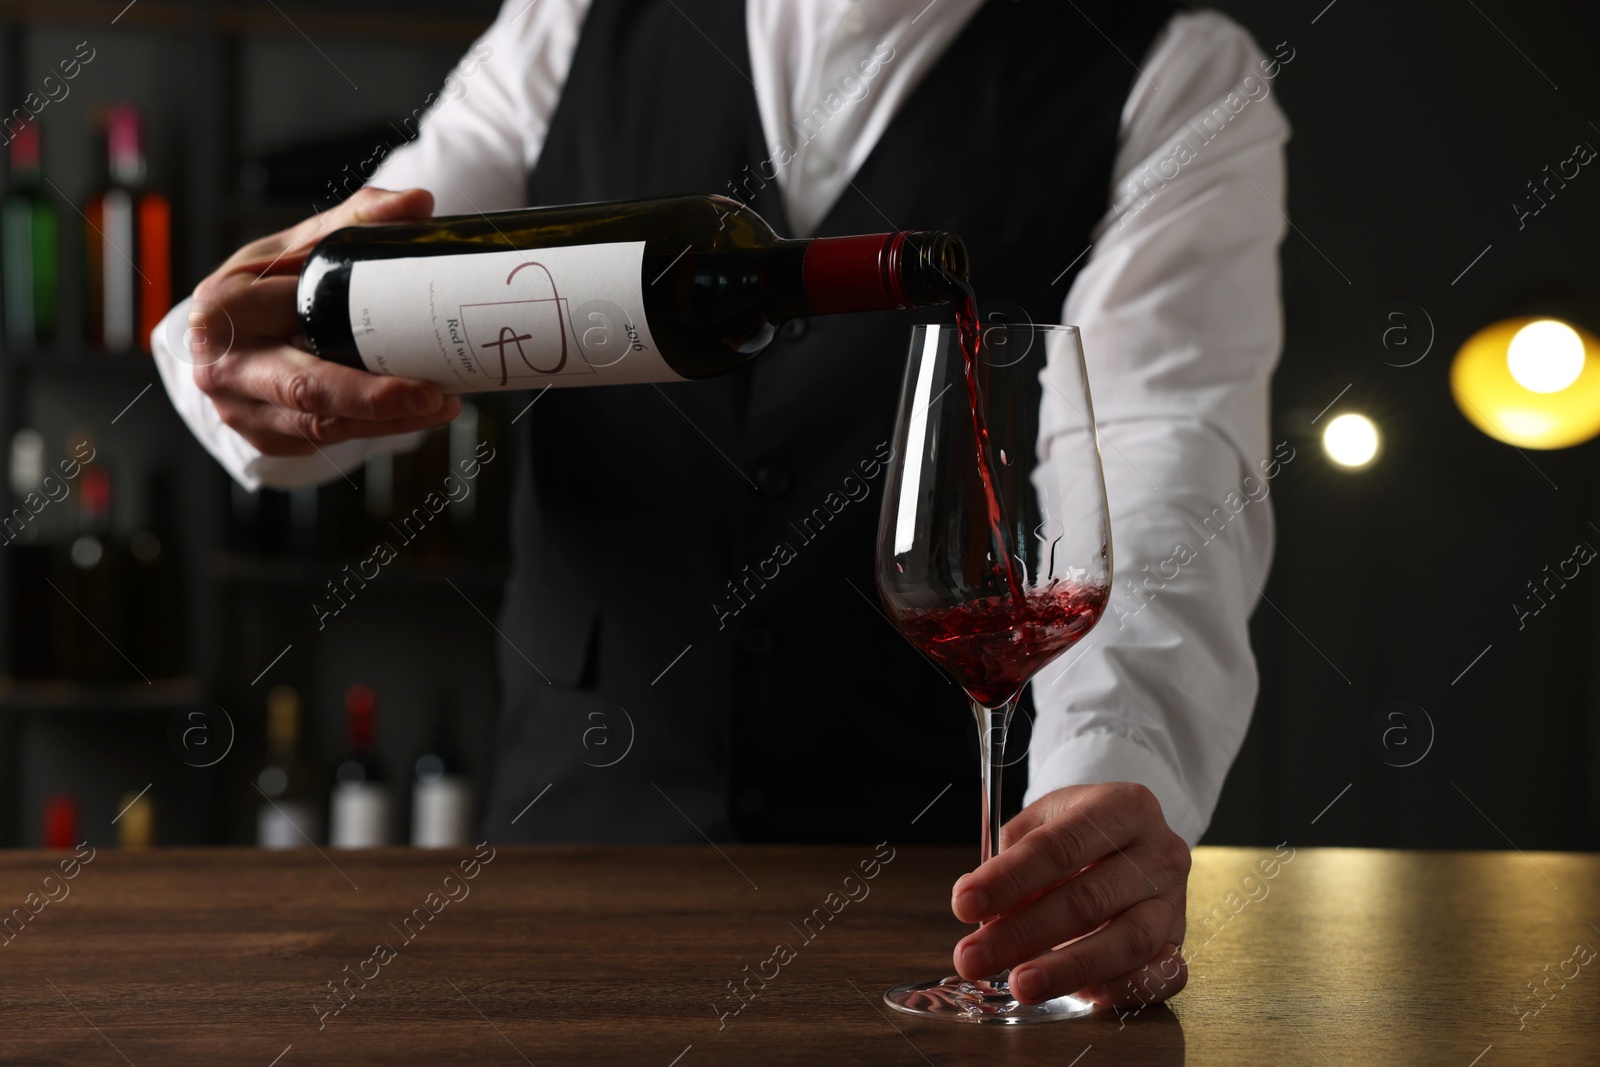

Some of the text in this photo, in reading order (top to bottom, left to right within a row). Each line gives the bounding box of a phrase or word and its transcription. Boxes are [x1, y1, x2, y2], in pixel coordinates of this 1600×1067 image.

[446, 318, 478, 375] Red wine
[624, 323, 649, 352] 2016
